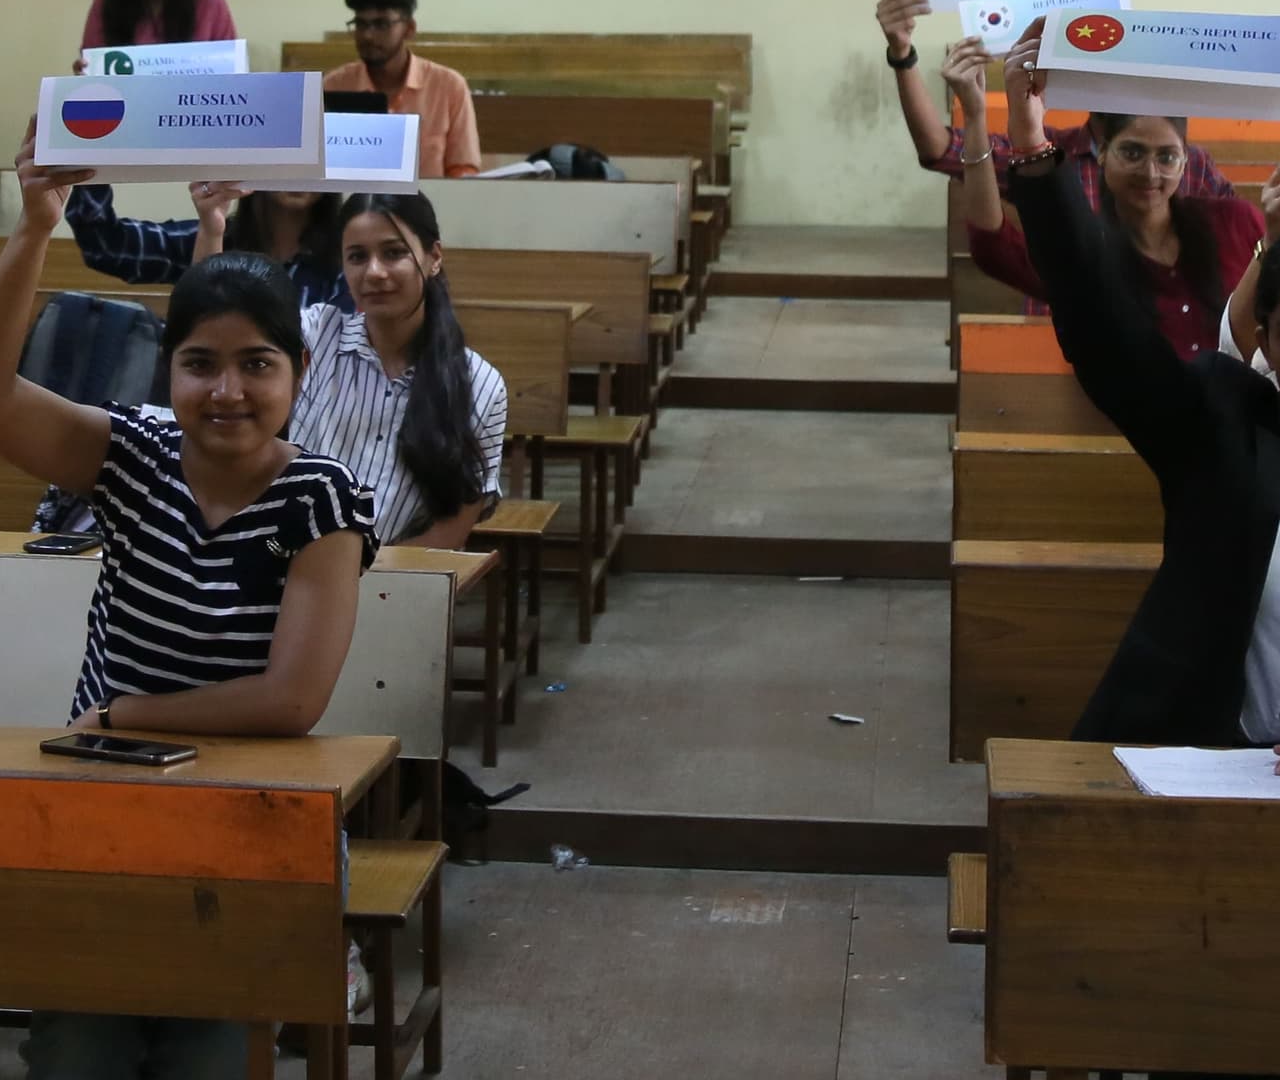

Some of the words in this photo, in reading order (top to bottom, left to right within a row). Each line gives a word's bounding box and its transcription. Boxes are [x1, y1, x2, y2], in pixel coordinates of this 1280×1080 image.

[1131, 23, 1200, 37] PEOPLE'S
[1202, 27, 1278, 41] REPUBLIC
[1189, 40, 1238, 53] CHINA
[177, 92, 249, 106] RUSSIAN
[157, 113, 267, 128] FEDERATION
[326, 135, 383, 146] ZEALAND
